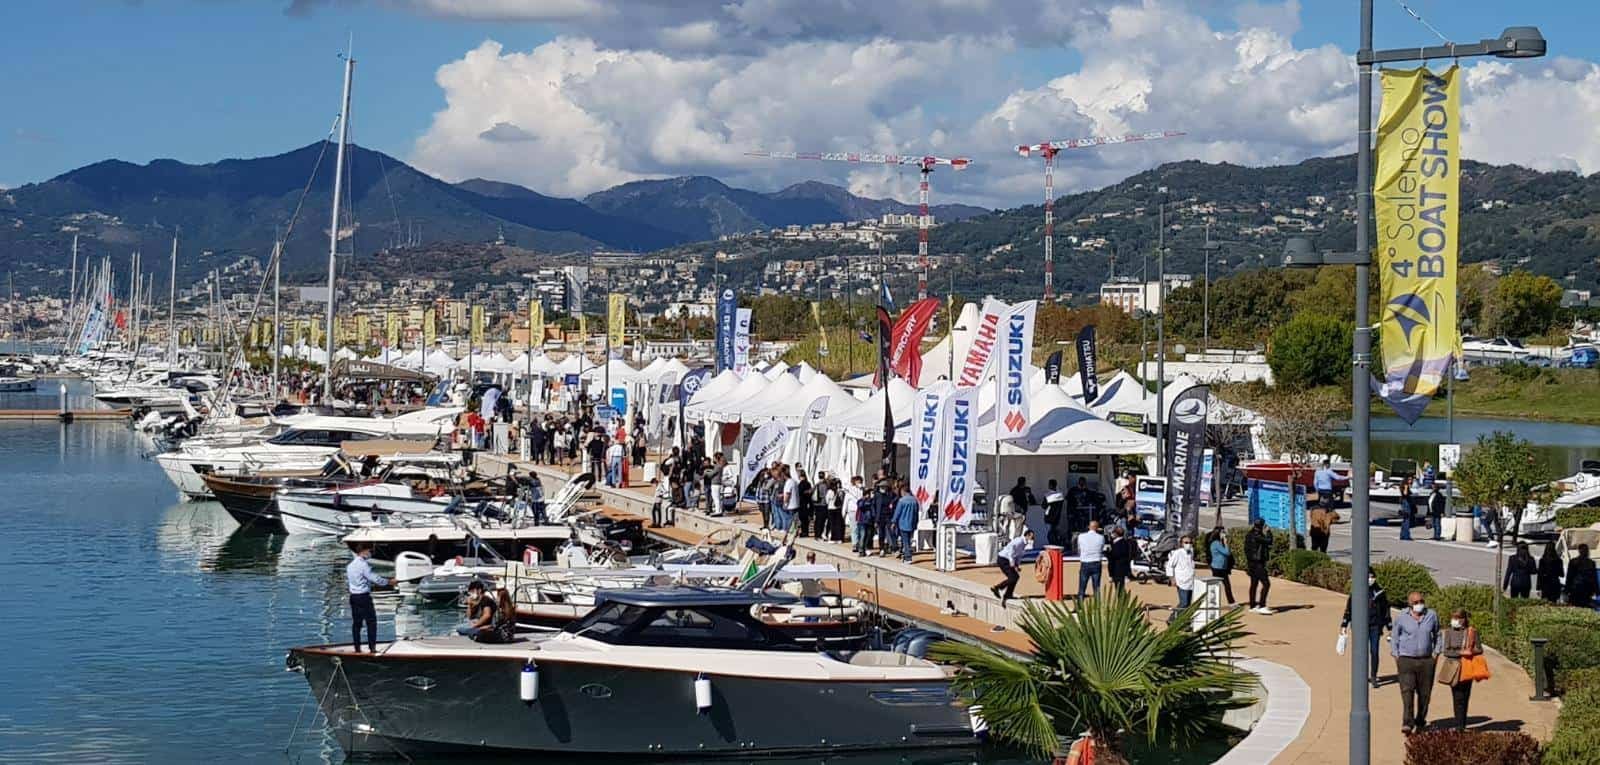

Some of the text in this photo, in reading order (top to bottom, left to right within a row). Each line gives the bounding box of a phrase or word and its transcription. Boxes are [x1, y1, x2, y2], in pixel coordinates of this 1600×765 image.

[1386, 128, 1419, 277] 4° Salerno
[1417, 74, 1448, 278] BOAT SHOW
[891, 314, 917, 366] MERCURY
[957, 313, 999, 387] YAMAHA
[1008, 314, 1025, 406] SUZUKI
[1082, 340, 1094, 378] TOHATSU
[918, 394, 939, 480] SUZUKI
[950, 399, 969, 495] SUZUKI
[1170, 431, 1189, 527] IDEA MARINE
